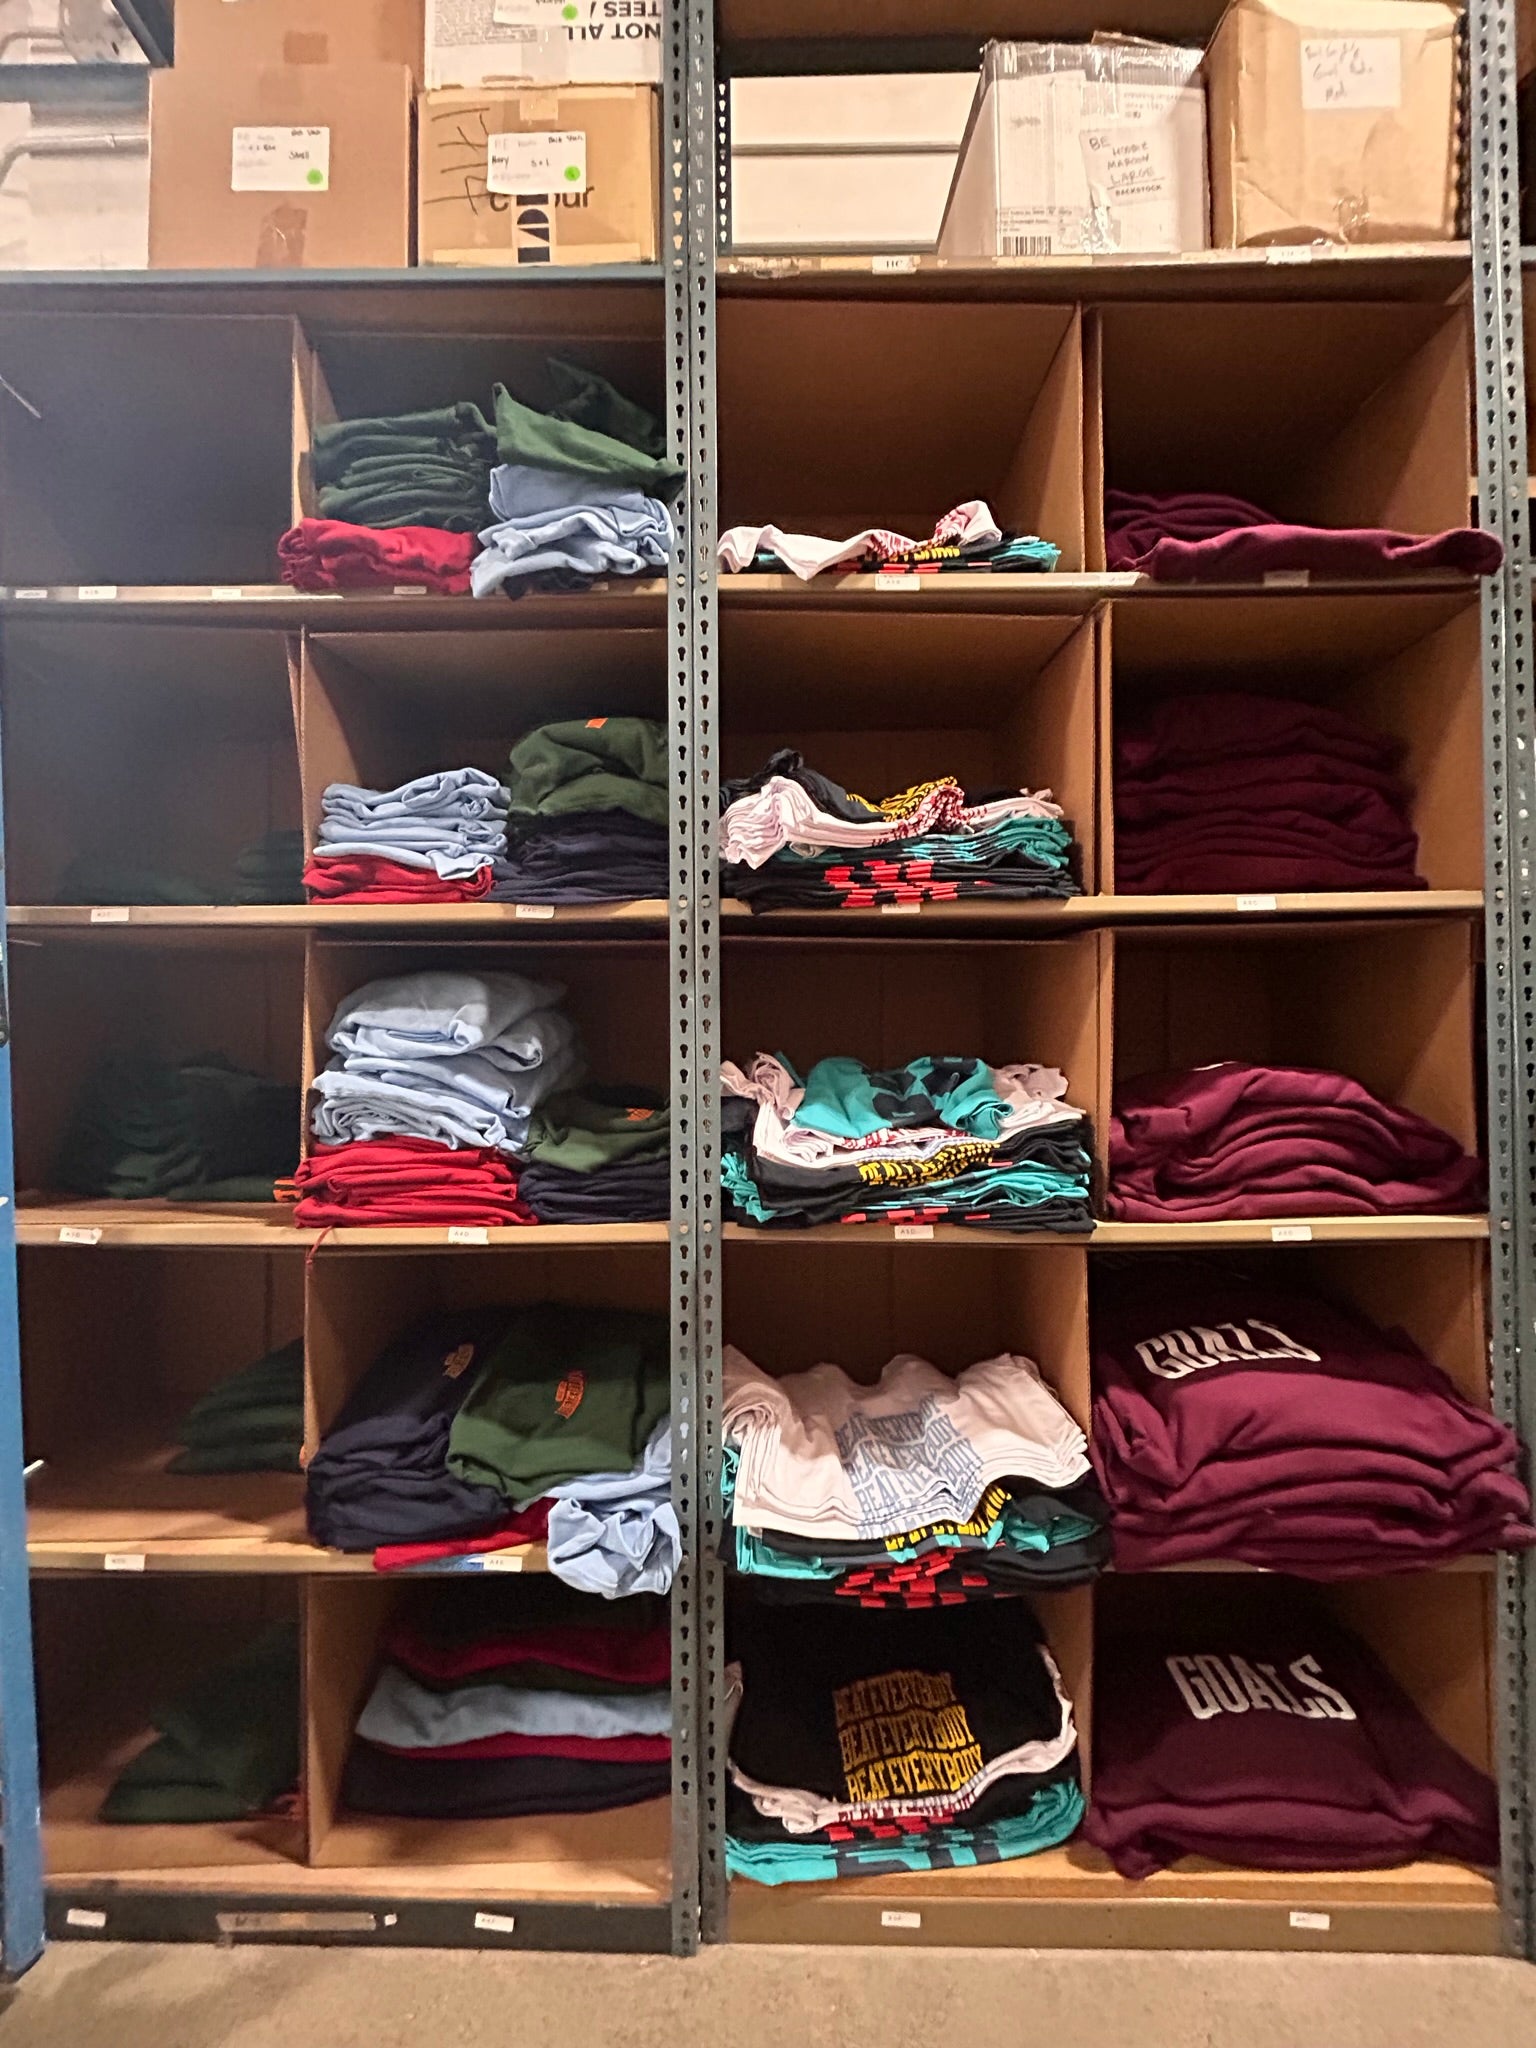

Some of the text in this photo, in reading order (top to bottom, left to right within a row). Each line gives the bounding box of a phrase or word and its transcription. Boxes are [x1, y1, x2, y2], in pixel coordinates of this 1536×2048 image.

[604, 0, 661, 17] TEES
[611, 22, 661, 39] NOT
[1003, 45, 1018, 74] M
[1088, 136, 1112, 151] BE
[1107, 153, 1149, 170] MAROON
[854, 1469, 901, 1508] BEAT
[1166, 1654, 1357, 1720] GOALS
[838, 1704, 975, 1773] BEAT EVERYBODY
[846, 1743, 984, 1802] BEAT EVERYBODY
